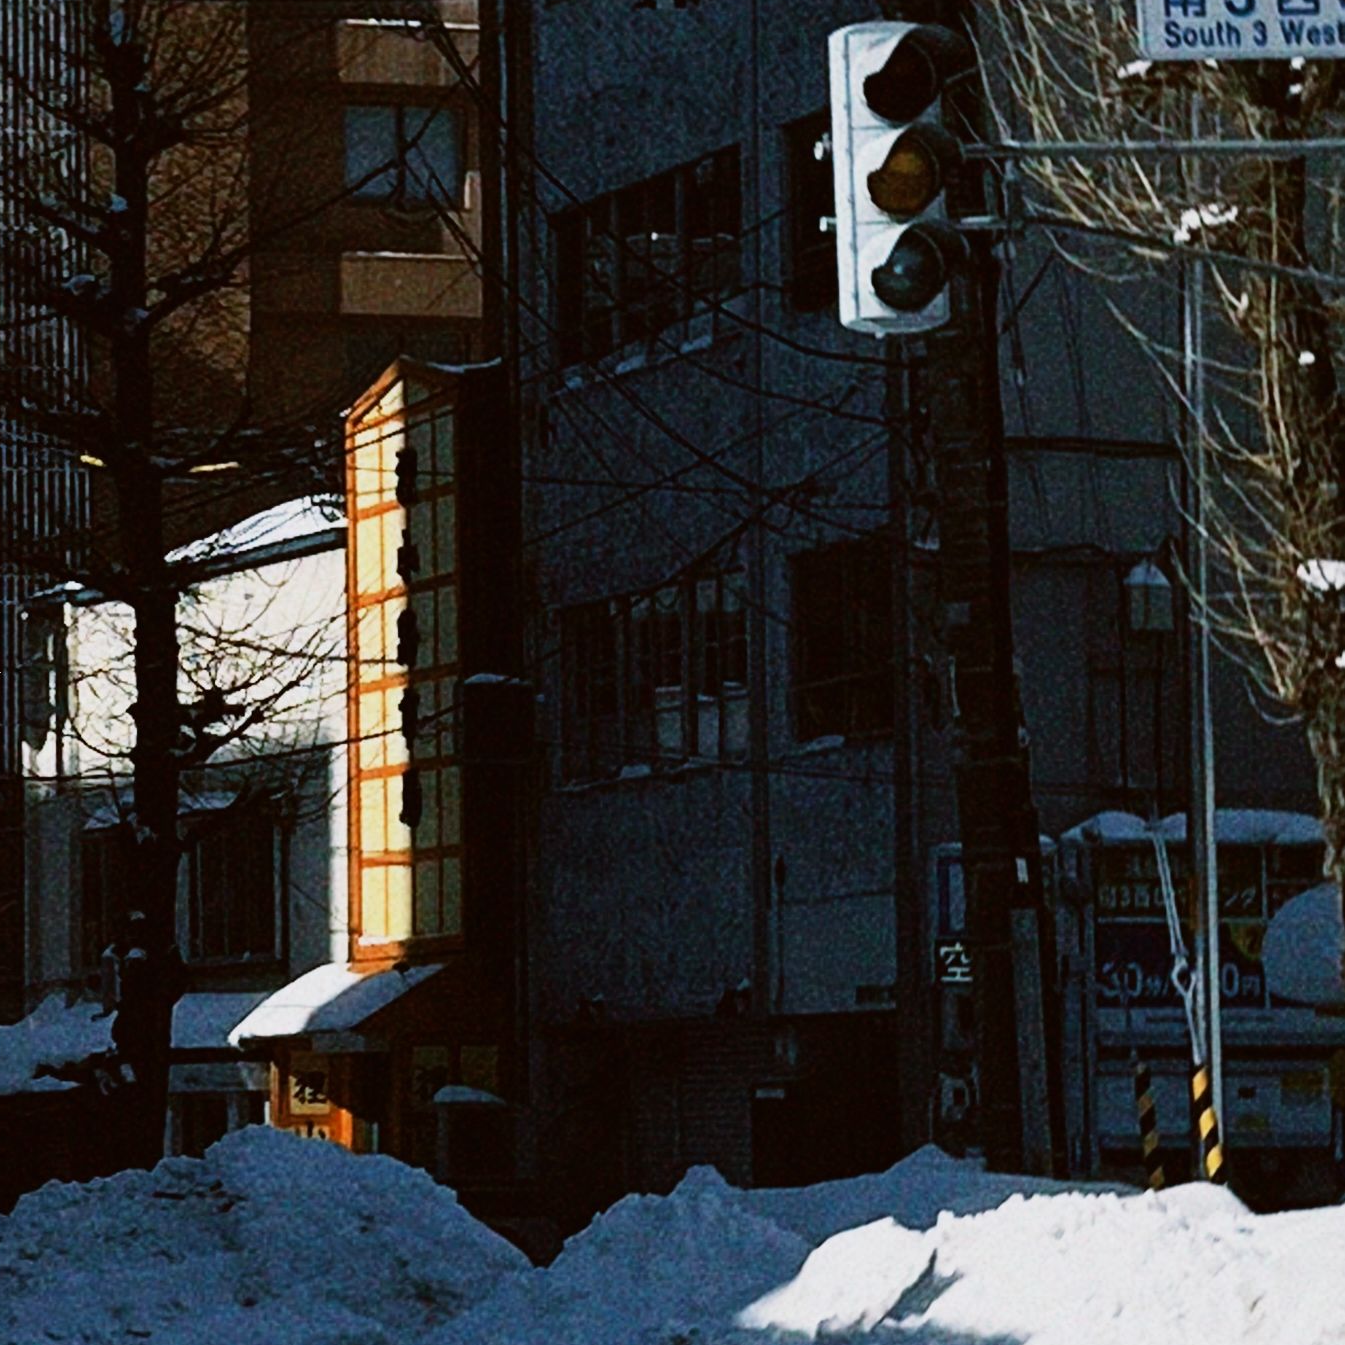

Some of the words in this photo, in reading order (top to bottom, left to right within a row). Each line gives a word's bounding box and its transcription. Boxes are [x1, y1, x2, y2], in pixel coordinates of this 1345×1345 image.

[1164, 21, 1241, 48] South
[1252, 21, 1268, 47] 3
[938, 941, 974, 984] 空
